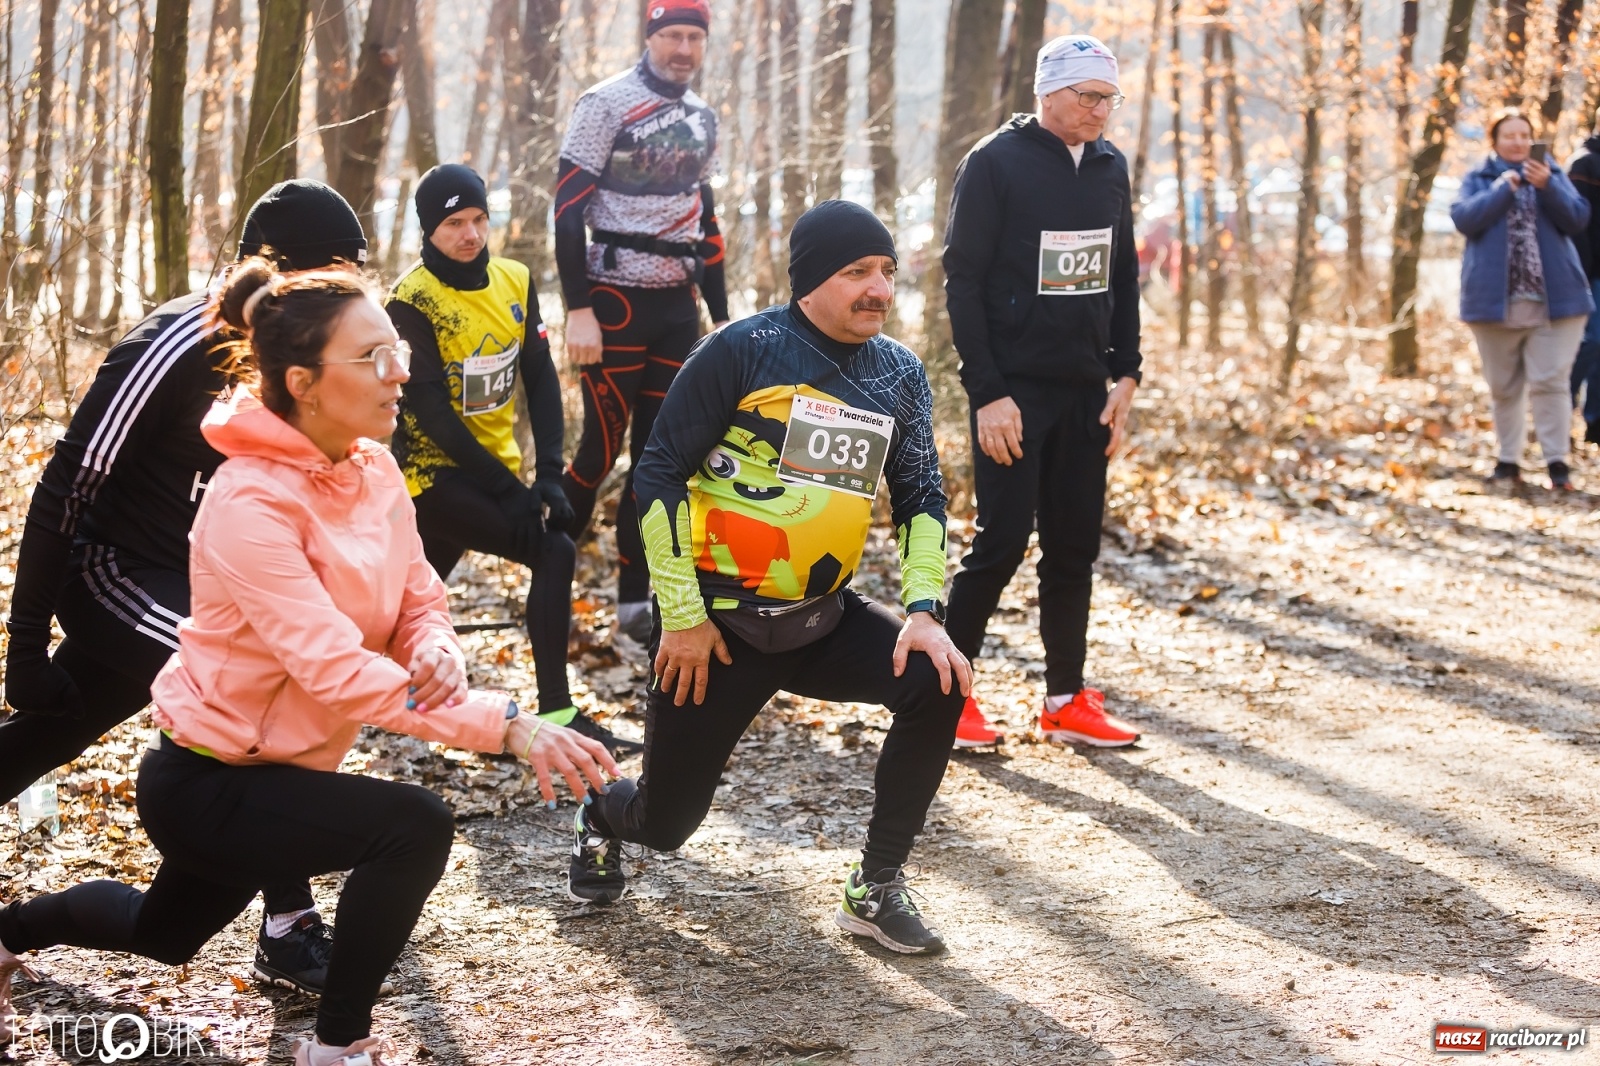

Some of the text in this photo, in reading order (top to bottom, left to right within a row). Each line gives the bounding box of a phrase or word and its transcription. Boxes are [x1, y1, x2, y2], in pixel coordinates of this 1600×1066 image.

[1058, 251, 1102, 276] 024
[482, 365, 514, 396] 145
[806, 401, 884, 427] X BIEG Twardziela
[807, 428, 871, 470] 033
